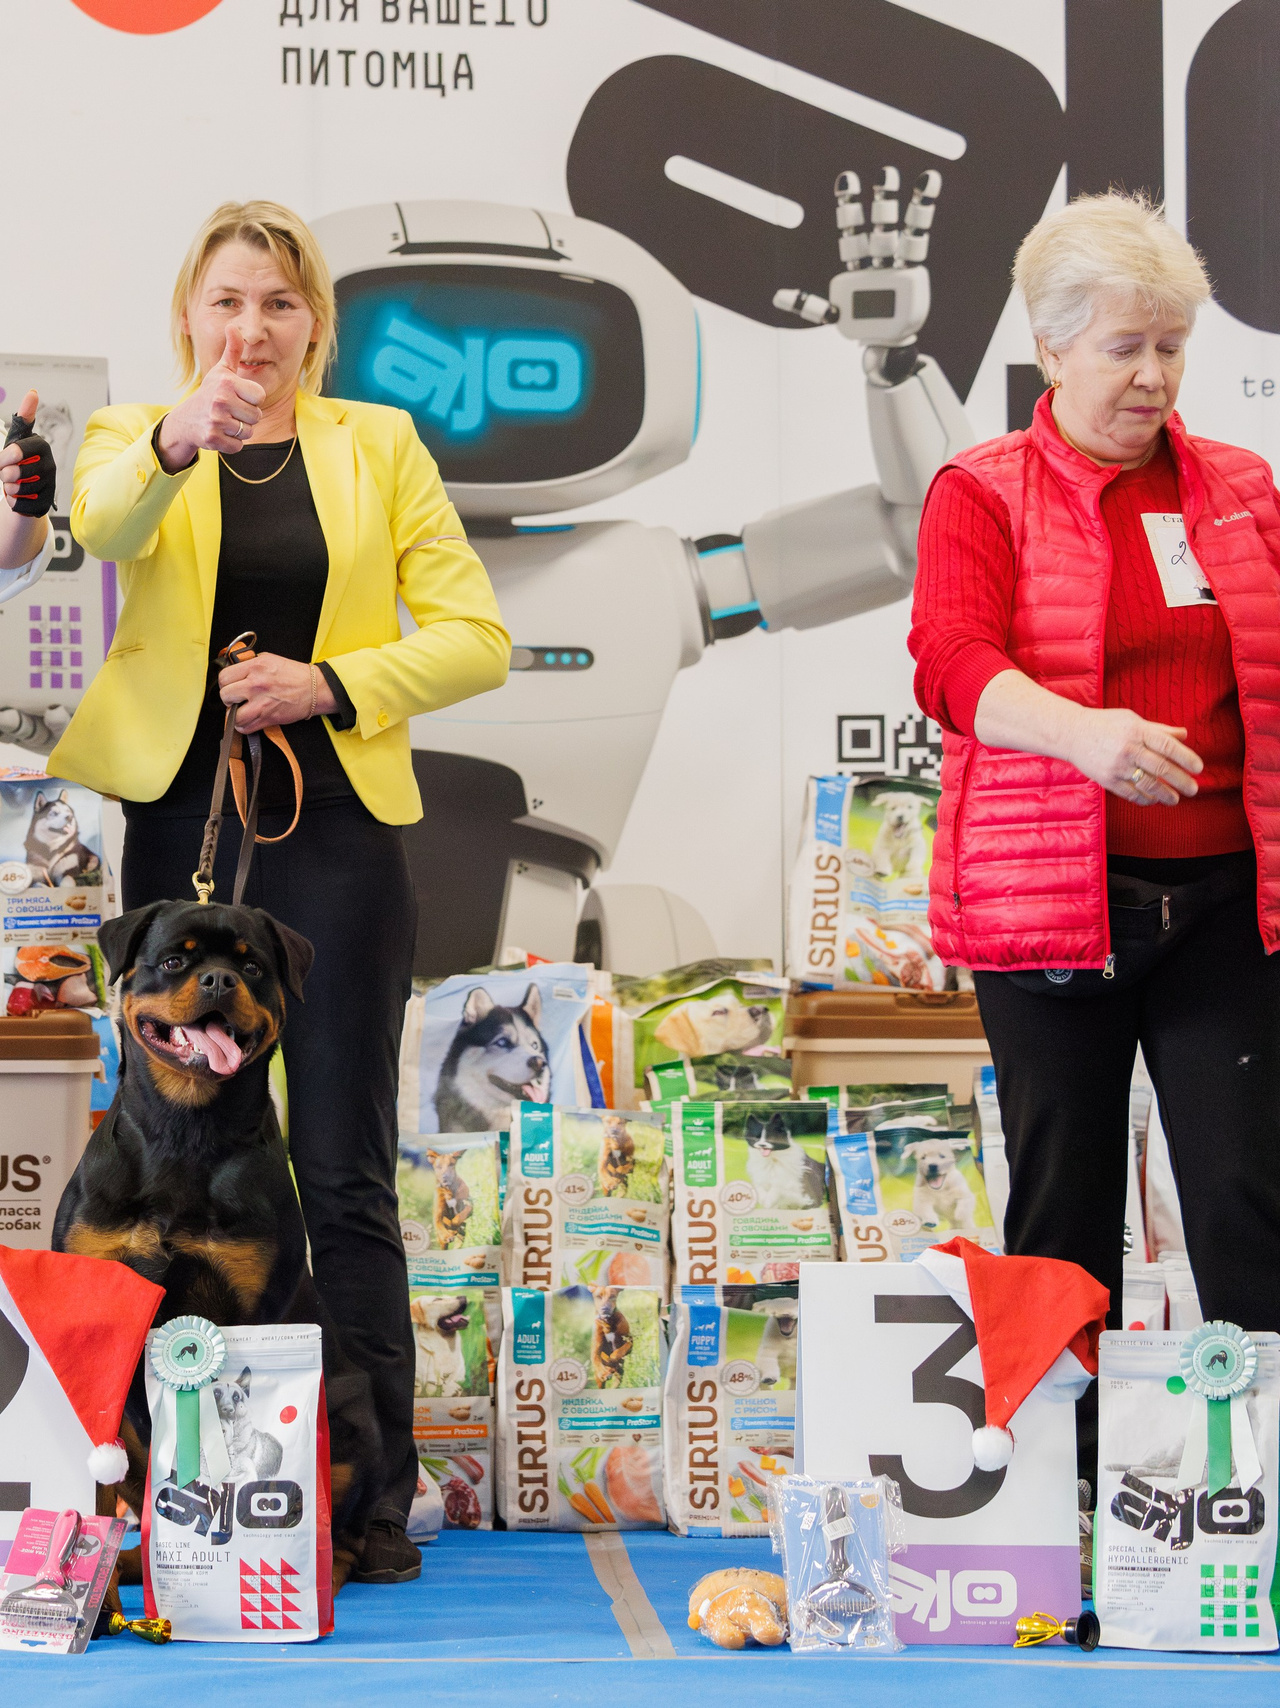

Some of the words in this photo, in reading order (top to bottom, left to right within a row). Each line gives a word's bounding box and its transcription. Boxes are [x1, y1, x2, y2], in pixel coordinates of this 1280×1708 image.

[280, 46, 476, 98] ПИТОМЦА
[15, 905, 64, 914] ОВОЩАМИ
[687, 1159, 712, 1170] ADULT
[523, 1187, 554, 1291] IRIUS
[516, 1333, 540, 1345] ADULT
[691, 1335, 715, 1346] PUPPY
[570, 1406, 618, 1414] ОВОЩАМИ
[867, 1294, 1008, 1519] 3
[514, 1377, 550, 1514] SIRIUS
[687, 1379, 720, 1511] SIRIUS
[155, 1541, 172, 1549] BASIC
[1108, 1545, 1136, 1553] SPECIAL
[155, 1550, 183, 1562] MAXI
[191, 1551, 231, 1563] ADULT
[1108, 1554, 1189, 1565] HYPOALLERGENIC
